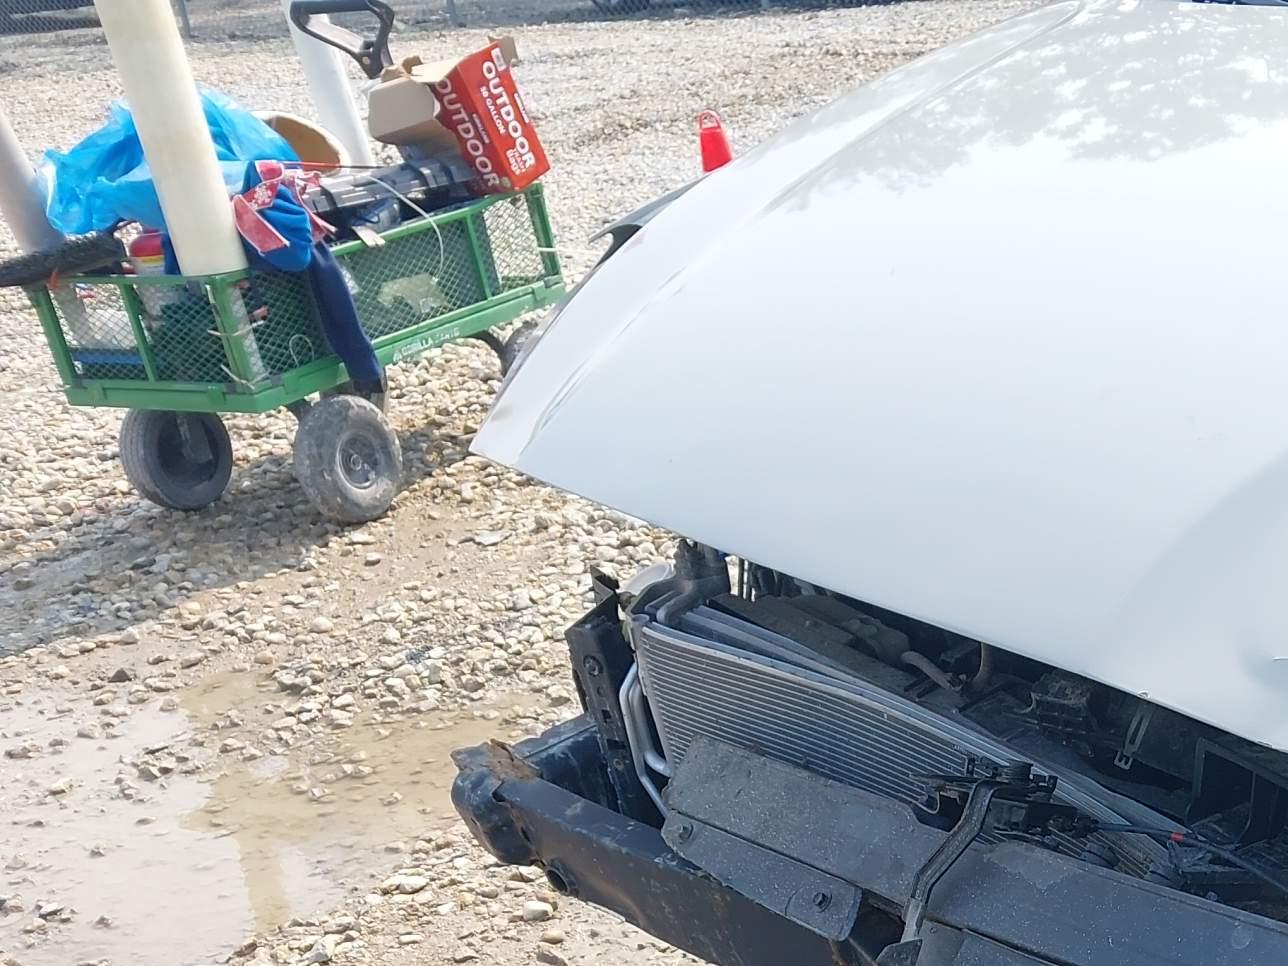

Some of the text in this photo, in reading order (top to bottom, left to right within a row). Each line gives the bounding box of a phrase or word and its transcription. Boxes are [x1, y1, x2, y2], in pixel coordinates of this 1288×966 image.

[435, 78, 499, 186] OUTDOOR
[482, 61, 535, 167] OUTDOOR
[486, 98, 505, 134] GALLON
